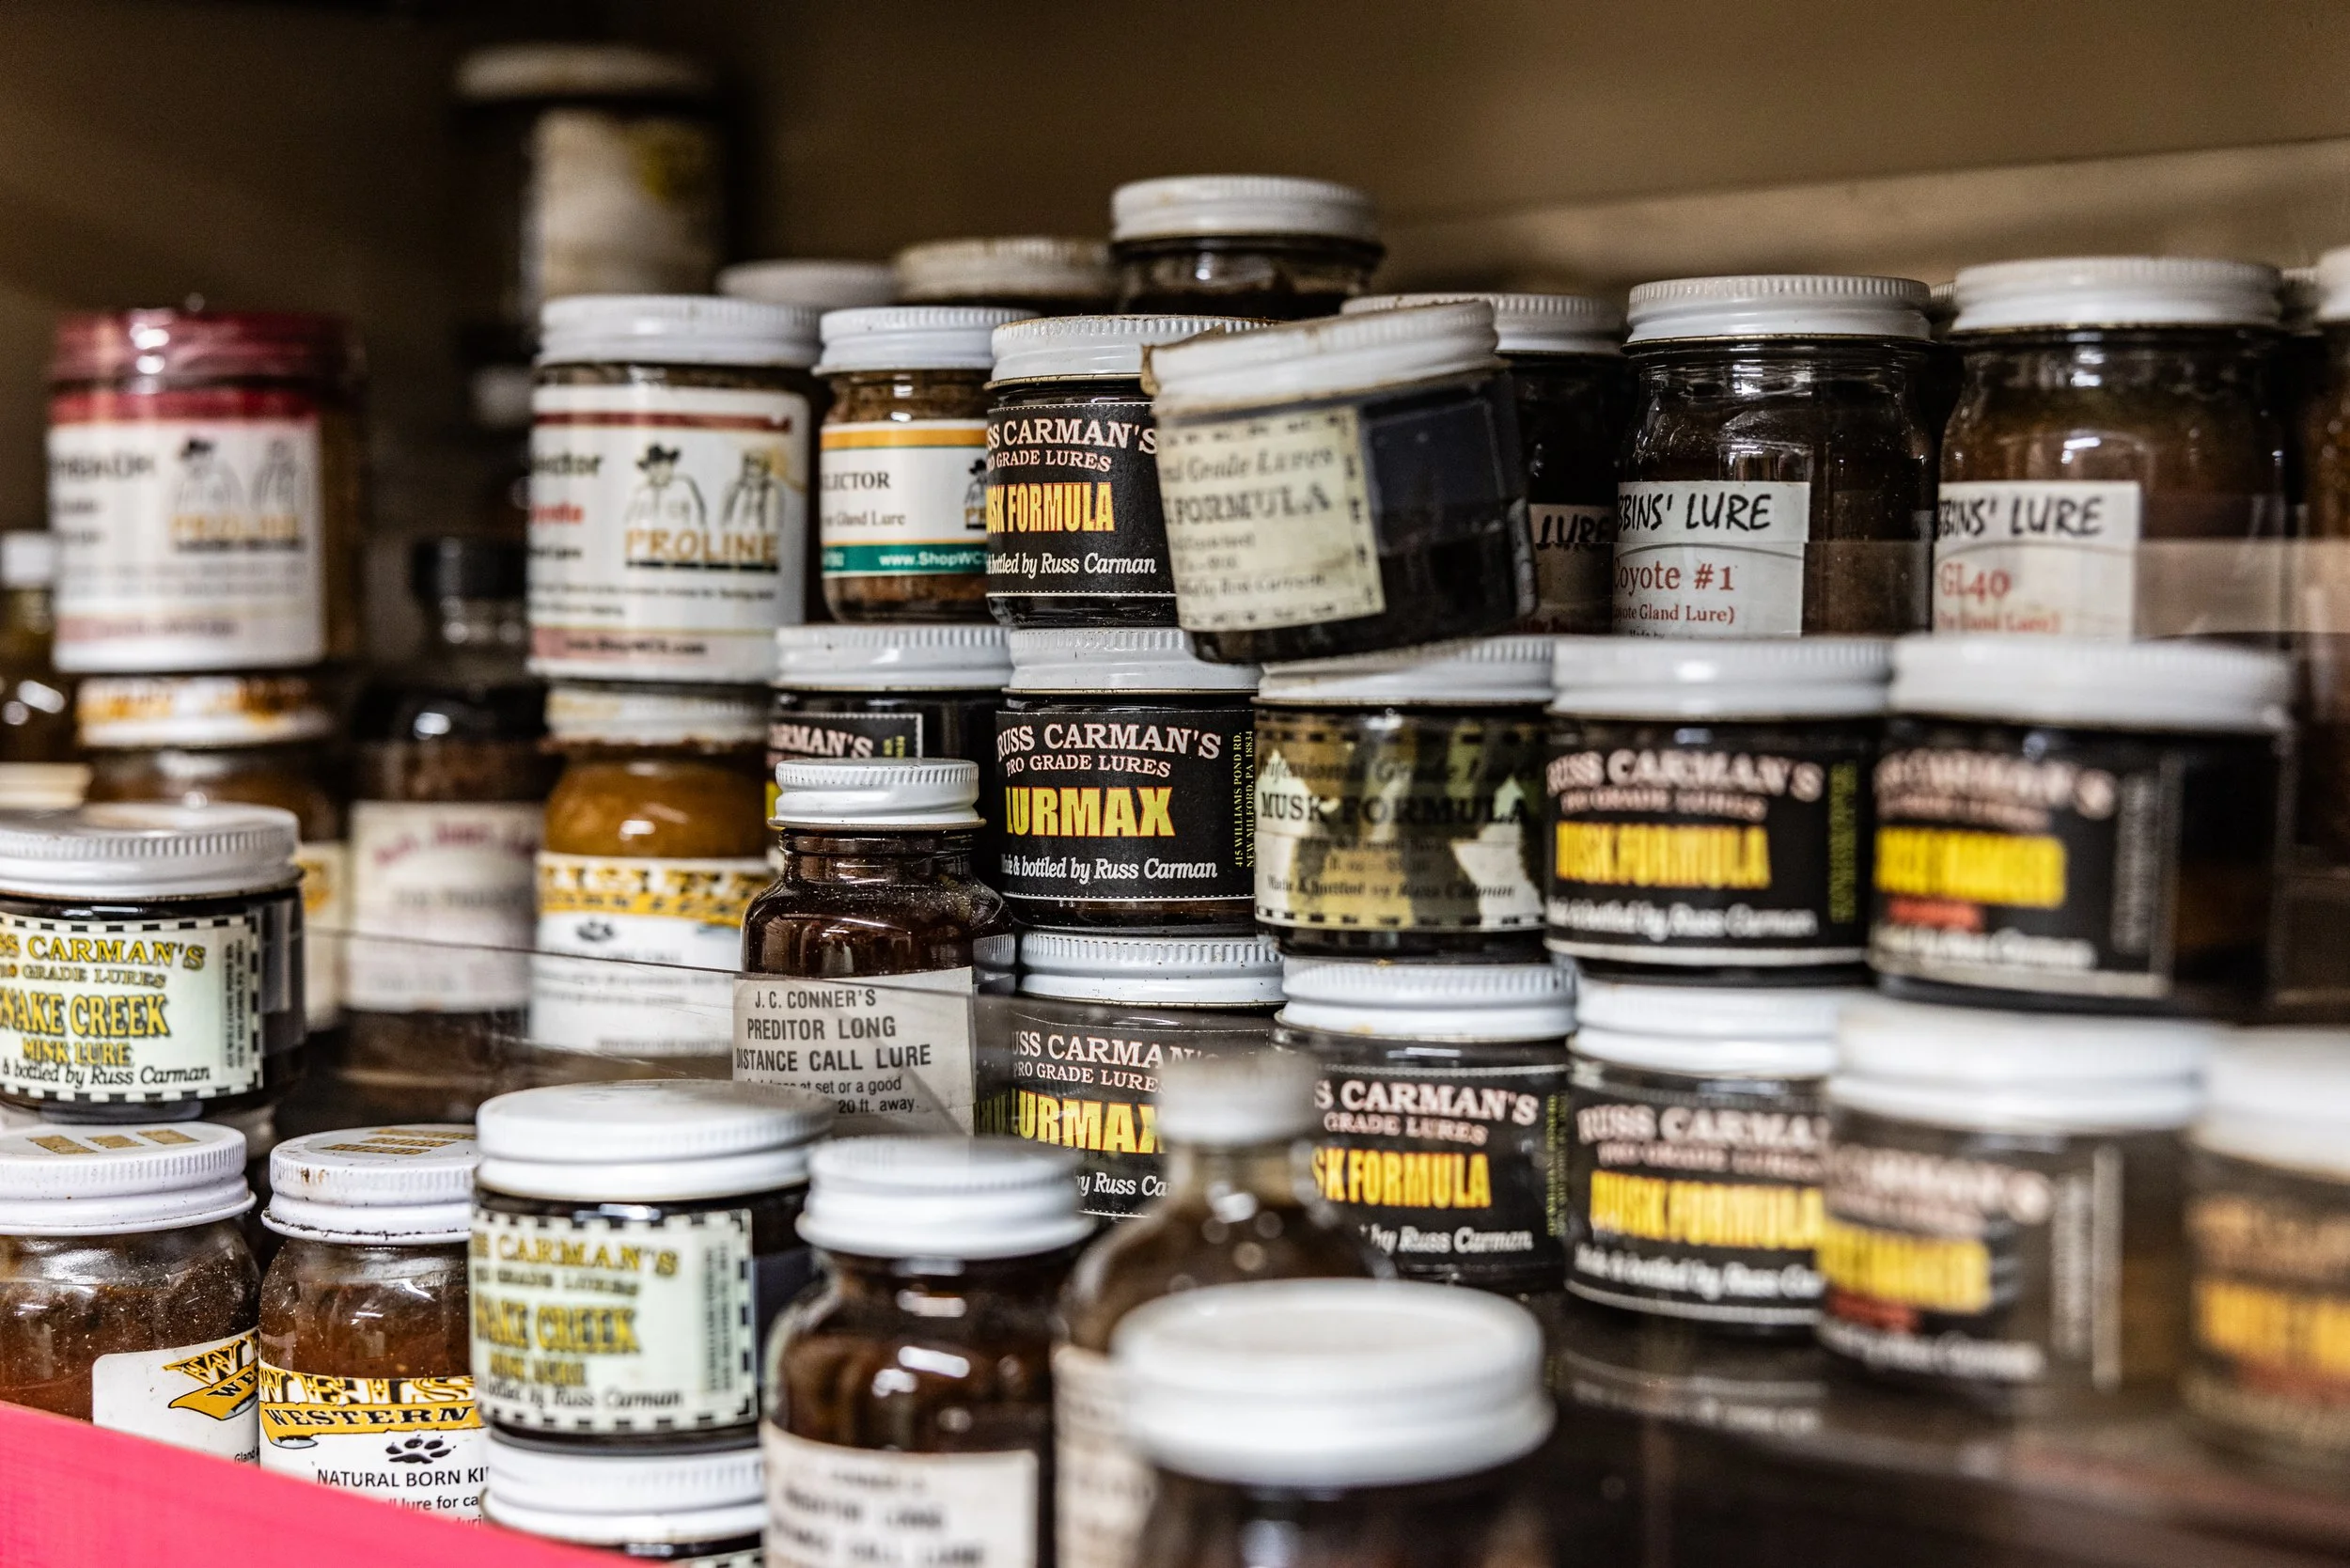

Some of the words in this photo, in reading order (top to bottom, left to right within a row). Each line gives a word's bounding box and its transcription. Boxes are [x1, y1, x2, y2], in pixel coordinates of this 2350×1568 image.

[1003, 418, 1157, 455] CARMAN'S
[996, 449, 1041, 468] GRADE
[1044, 449, 1112, 473] LURES
[872, 509, 907, 526] Lure
[1007, 481, 1116, 533] FORMULA
[1685, 491, 1772, 532] LURE
[2011, 496, 2104, 537] LURE
[624, 528, 780, 562] PROLINE
[1022, 552, 1038, 579] by
[1040, 552, 1080, 574] Russ
[1084, 552, 1157, 574] Carman
[1639, 604, 1679, 621] Gland
[1685, 604, 1735, 625] Lure)
[996, 725, 1035, 762] RUSS
[1043, 724, 1221, 760] CARMAN'S
[1232, 731, 1242, 751] RD.
[1006, 757, 1025, 778] PRO
[1029, 754, 1092, 771] GRADE
[1098, 755, 1172, 778] LURES
[1233, 753, 1242, 786] POND
[1246, 763, 1254, 779] PA
[1005, 787, 1176, 837] LURMAX
[1233, 788, 1243, 848] WILLIAMS
[1246, 780, 1255, 839] MILFORD,
[1261, 792, 1326, 823] MUSK
[1234, 850, 1244, 867] 415
[1246, 841, 1255, 868] NEW
[1013, 855, 1020, 875] &
[1022, 856, 1067, 879] bottled
[1070, 856, 1090, 885] by
[1093, 857, 1139, 879] Russ
[1143, 857, 1218, 879] Carman
[27, 935, 207, 971] CARMAN'S
[22, 964, 88, 983] GRADE
[94, 967, 168, 989] LURES
[755, 992, 766, 1009] J.
[769, 992, 782, 1009] C.
[787, 989, 877, 1009] CONNER'S
[70, 994, 172, 1039] CREEK
[747, 1017, 825, 1041] PREDITOR
[838, 1016, 896, 1039] LONG
[22, 1037, 70, 1065] MINK
[74, 1042, 134, 1067] LURE
[736, 1049, 799, 1072] DISTANCE
[808, 1049, 863, 1071] CALL
[876, 1043, 932, 1070] LURE
[14, 1059, 59, 1082] bottled
[66, 1062, 86, 1090] by
[90, 1066, 133, 1085] Russ
[141, 1066, 212, 1086] Carman
[815, 1081, 835, 1094] set
[838, 1082, 851, 1094] or
[856, 1084, 864, 1093] a
[868, 1076, 902, 1096] good
[1013, 1060, 1033, 1078] PRO
[1036, 1063, 1094, 1084] GRADE
[838, 1100, 855, 1114] 20
[859, 1099, 874, 1113] ft.
[879, 1098, 920, 1113] away.
[1340, 1080, 1540, 1126] CARMAN'S
[1092, 1171, 1136, 1197] Russ
[1348, 1149, 1492, 1210] FORMULA
[1398, 1225, 1451, 1253] Russ
[1453, 1226, 1534, 1254] Carman
[264, 1404, 476, 1426] WESTERN
[317, 1467, 400, 1488] NATURAL
[405, 1468, 461, 1487] BORN
[436, 1497, 459, 1511] for
